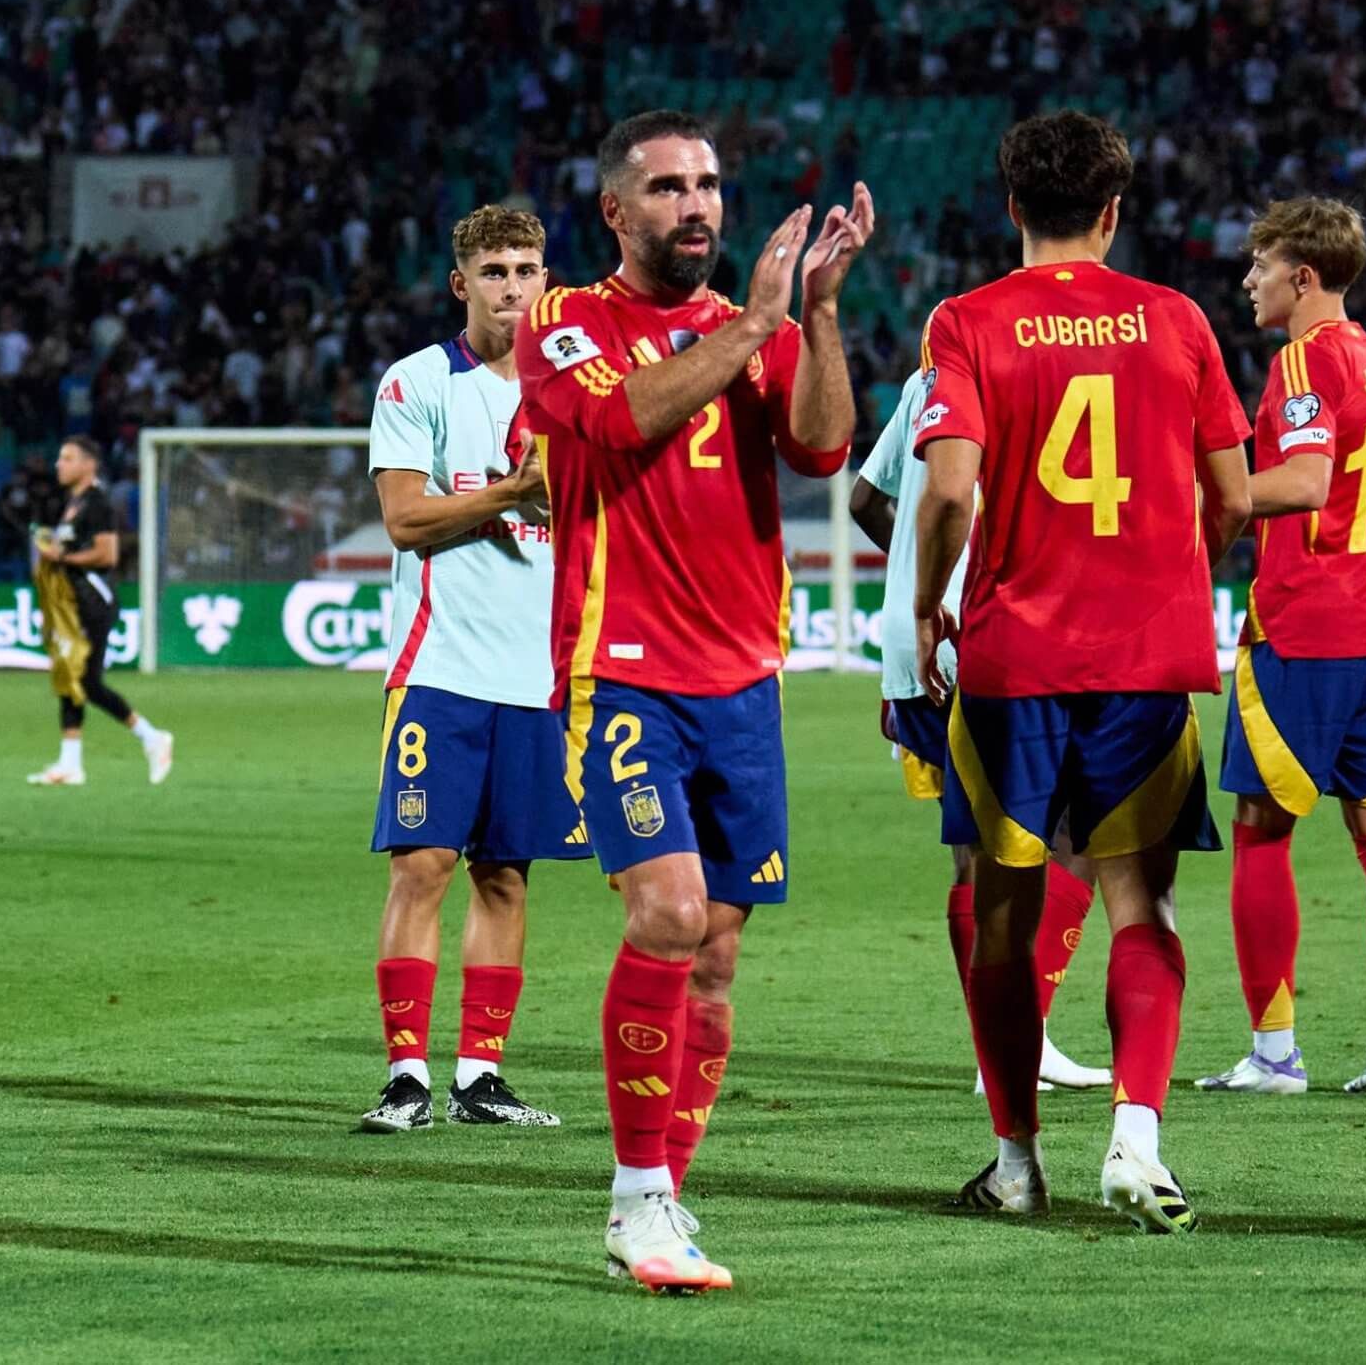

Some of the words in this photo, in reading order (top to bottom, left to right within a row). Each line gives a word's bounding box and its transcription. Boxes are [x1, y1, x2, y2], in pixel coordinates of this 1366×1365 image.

[1014, 304, 1147, 348] CUBARSÍ
[689, 401, 723, 468] 2
[1037, 373, 1132, 537] 4
[398, 722, 427, 778] 8
[605, 712, 648, 782] 2
